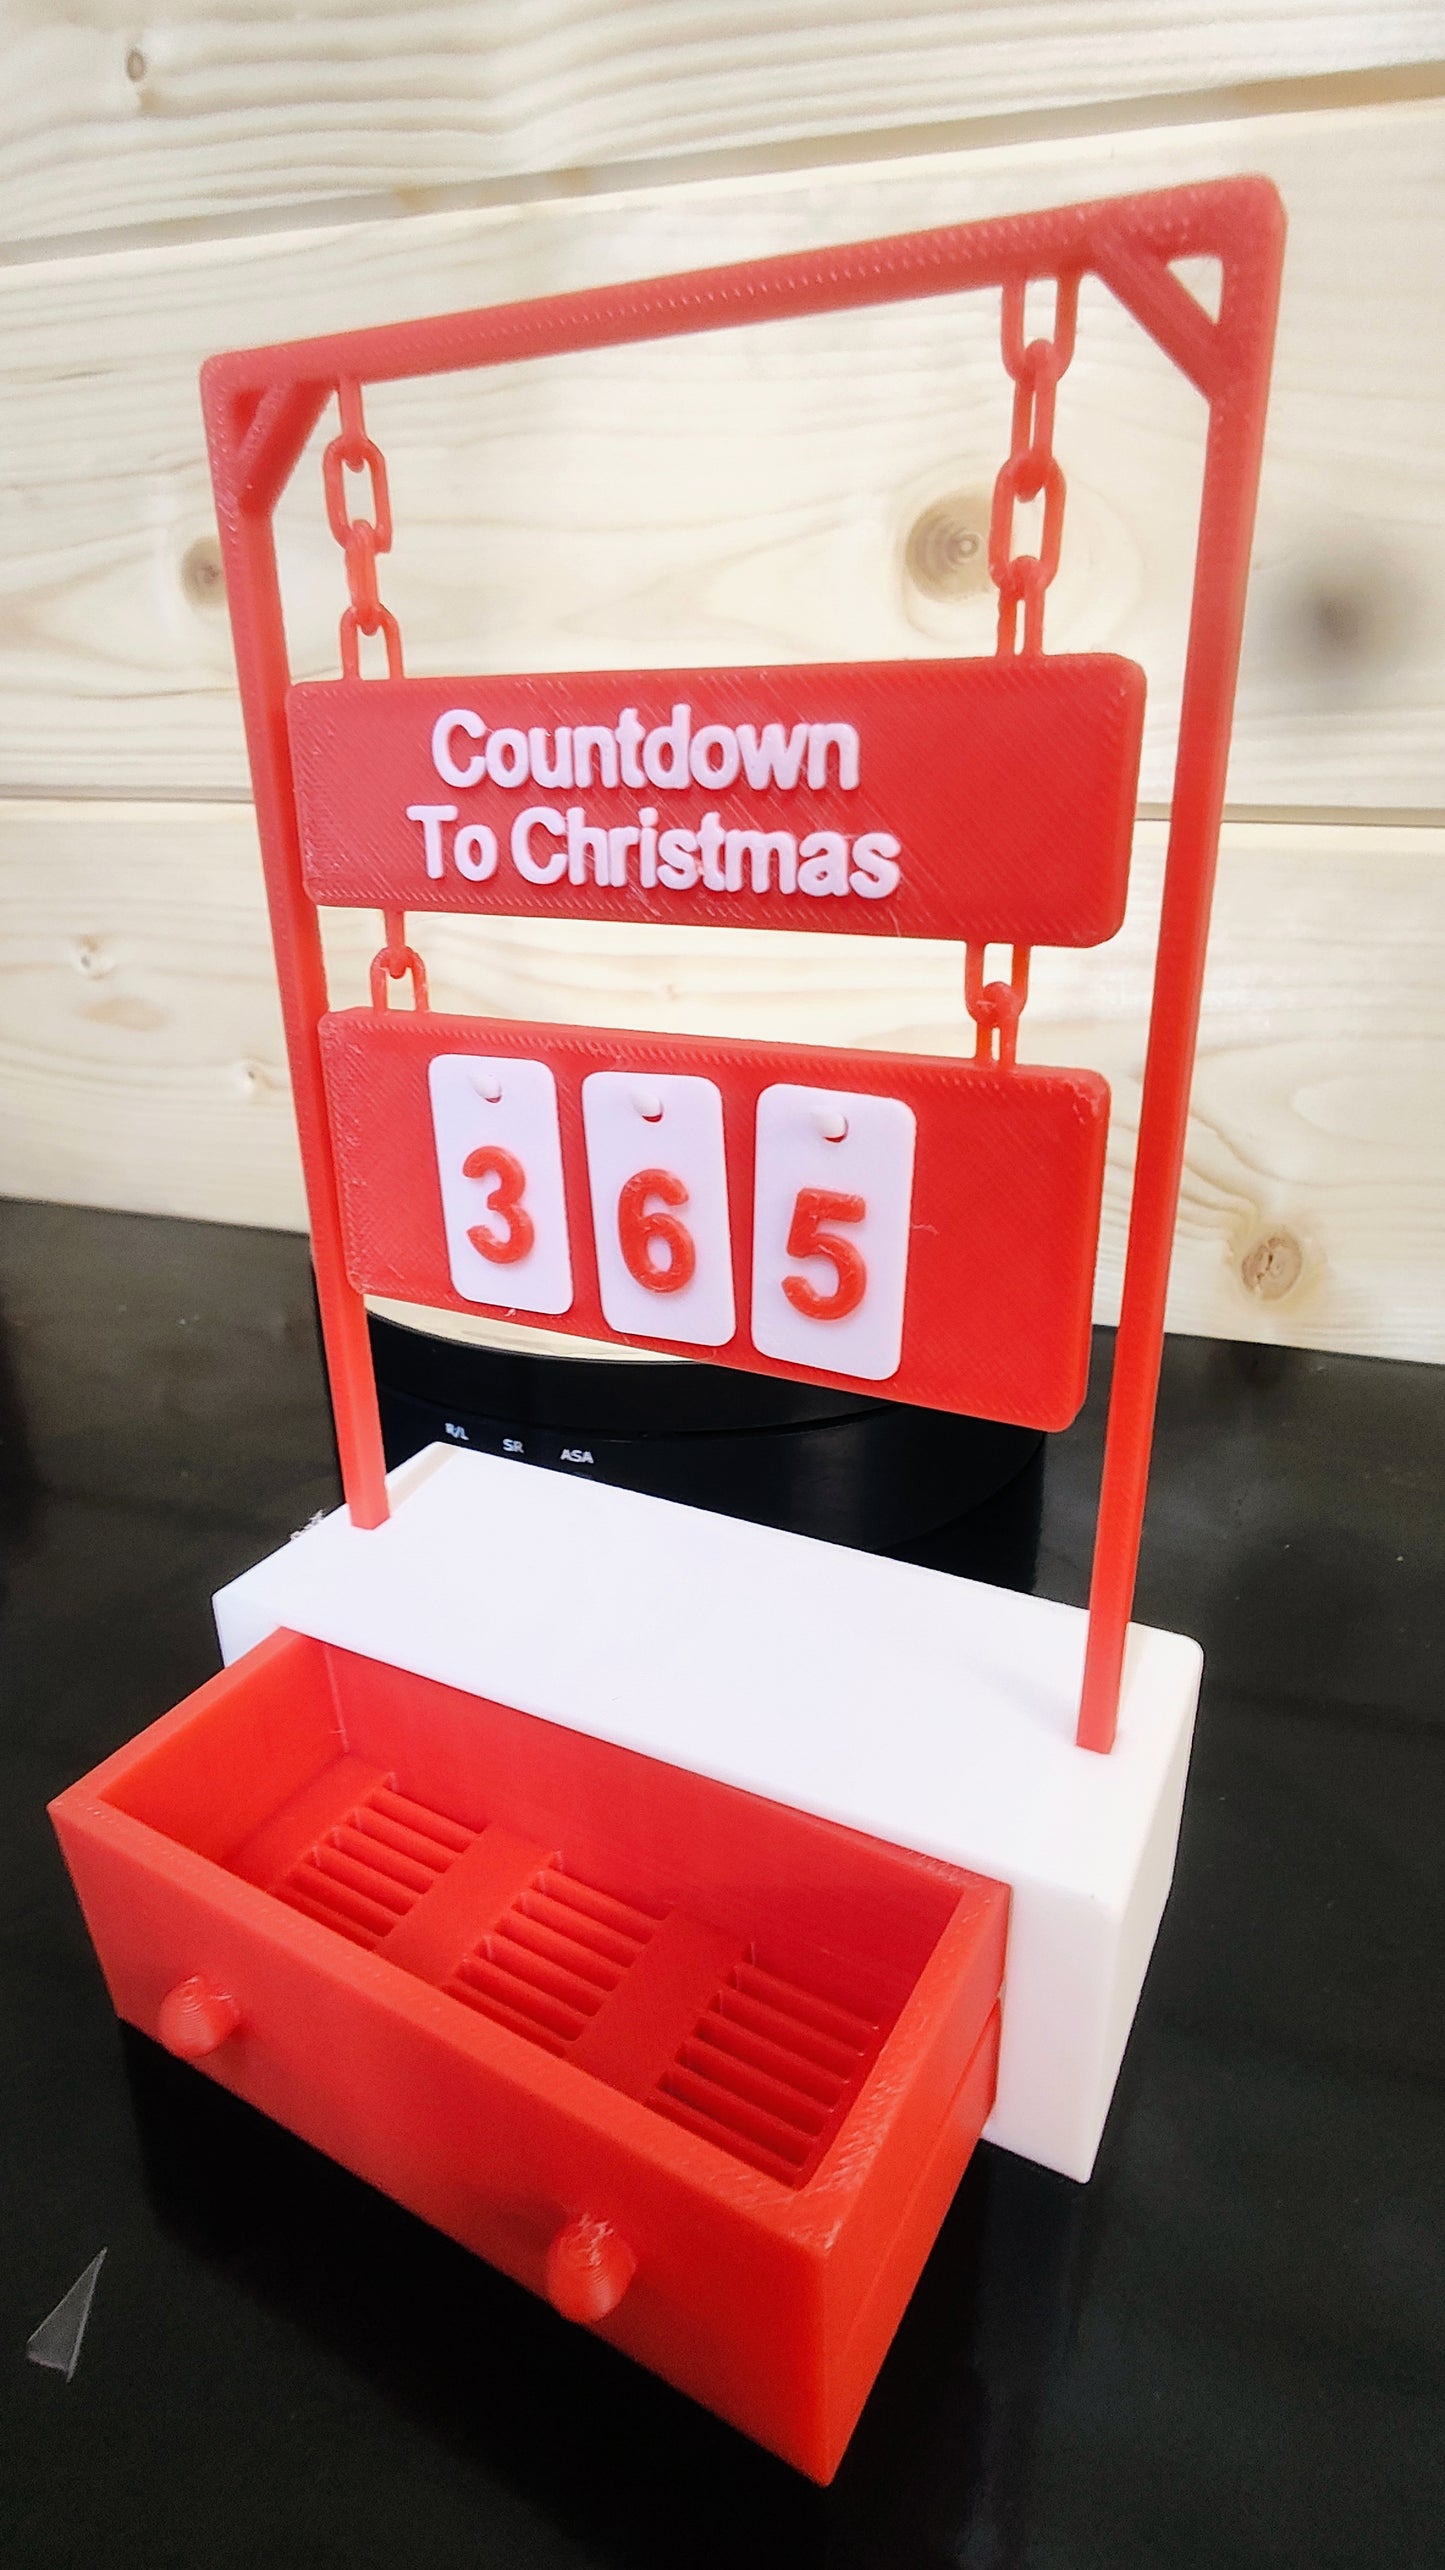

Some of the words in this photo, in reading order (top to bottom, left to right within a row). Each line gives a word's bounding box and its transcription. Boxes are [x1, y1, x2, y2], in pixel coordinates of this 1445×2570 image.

[431, 703, 860, 790] Countdown
[406, 805, 498, 881] To
[511, 806, 901, 899] Christmas
[502, 1438, 524, 1454] SR
[560, 1449, 594, 1464] ASA
